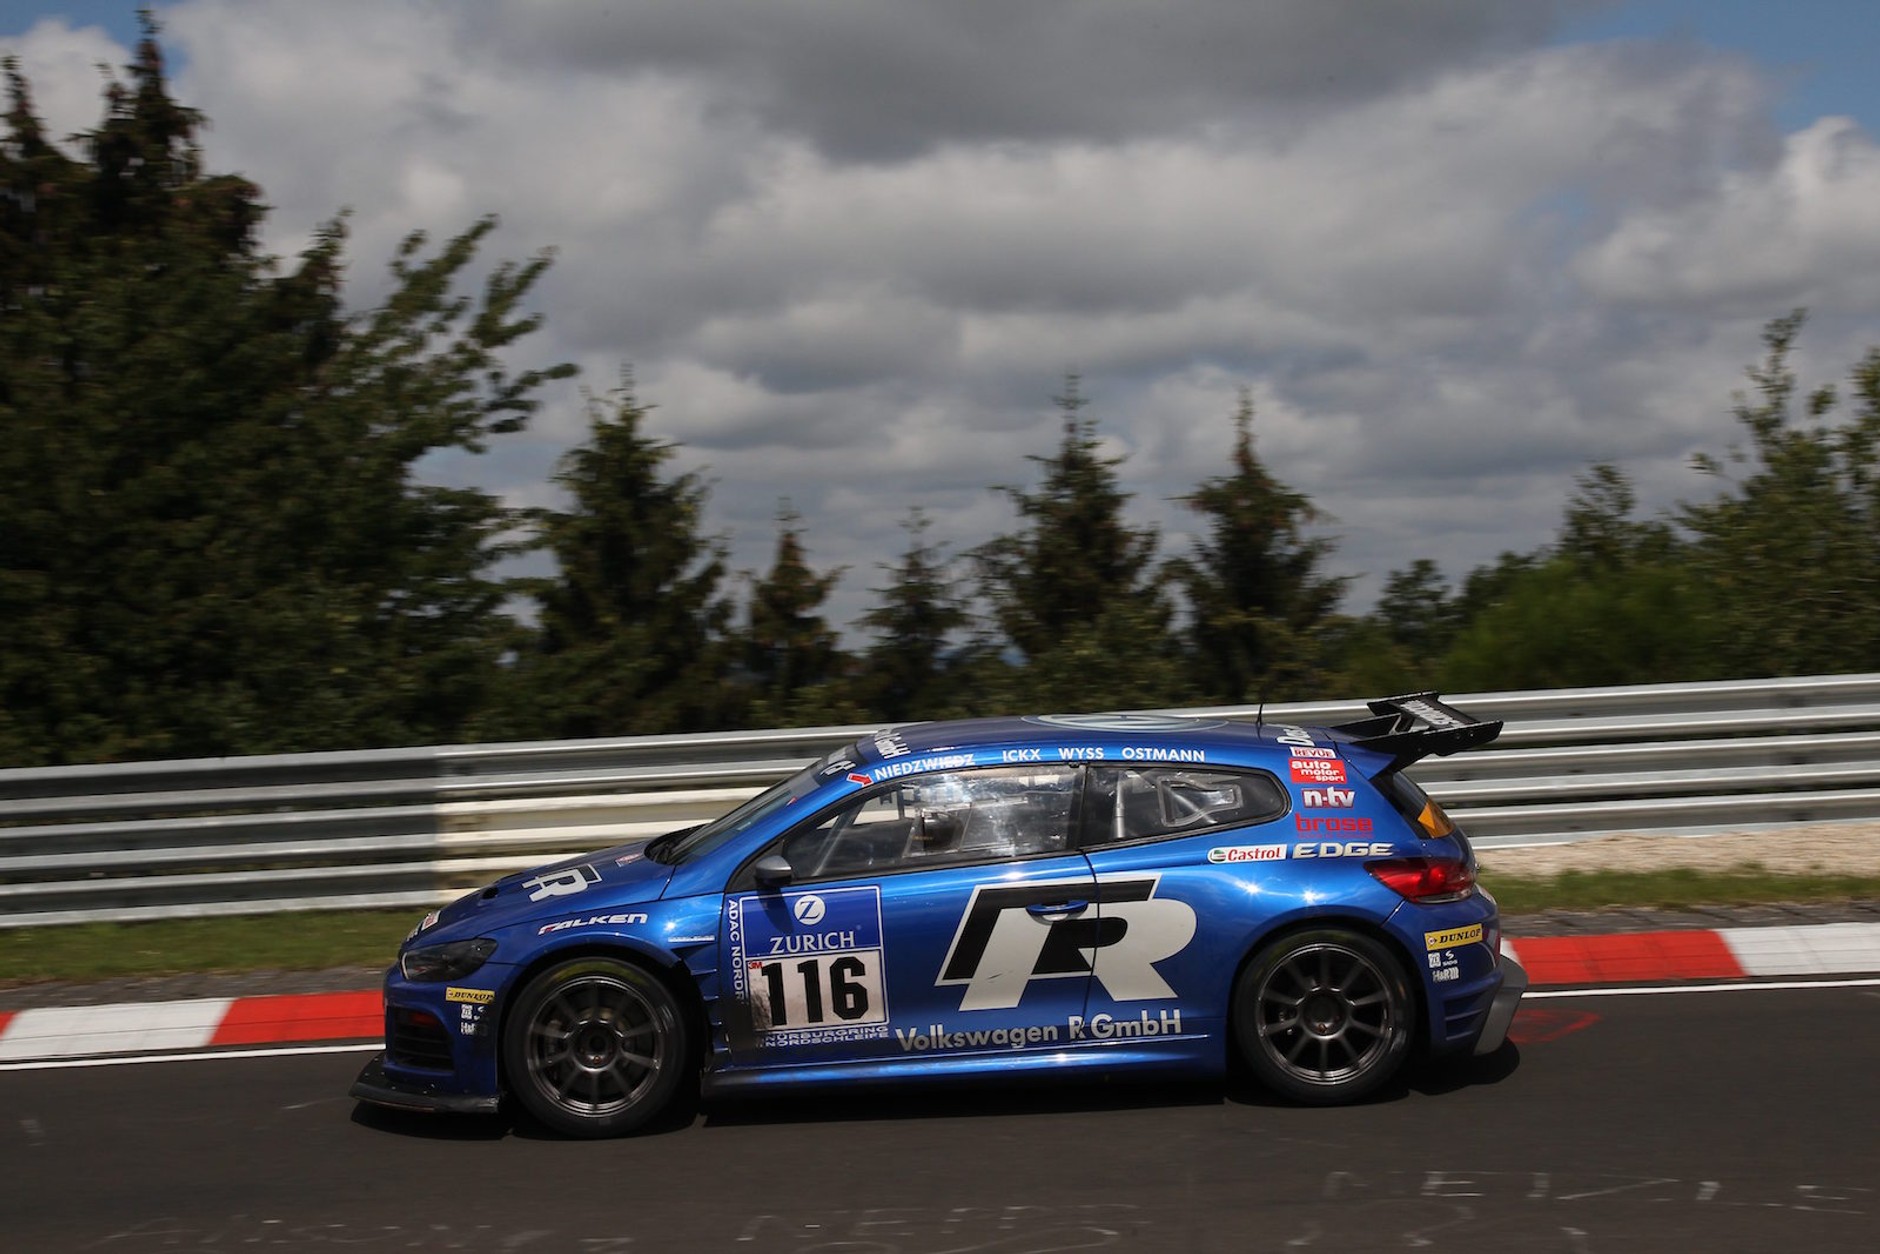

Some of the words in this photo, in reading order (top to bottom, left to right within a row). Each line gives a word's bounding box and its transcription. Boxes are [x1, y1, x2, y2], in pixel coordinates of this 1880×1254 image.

[1294, 749, 1333, 757] REVUE
[875, 754, 975, 780] NIEDZWIEDZ
[1003, 748, 1041, 762] ICKX
[1058, 747, 1104, 760] WYSS
[1122, 747, 1205, 762] OSTMANN
[1291, 760, 1331, 769] auto
[1301, 768, 1340, 776] motor
[1303, 786, 1355, 807] n-tv
[1295, 812, 1373, 831] brose
[1227, 848, 1281, 862] Castrol
[1292, 842, 1394, 859] EDGE
[538, 913, 648, 936] FALKEN
[728, 900, 740, 942] ADAC
[770, 931, 855, 955] ZURICH
[1440, 928, 1481, 944] DUNLOP
[749, 961, 763, 970] 3M
[762, 956, 868, 1027] 116
[895, 1024, 1058, 1051] Volkswagen
[1068, 1015, 1086, 1040] R
[1090, 1009, 1182, 1039] GmbH
